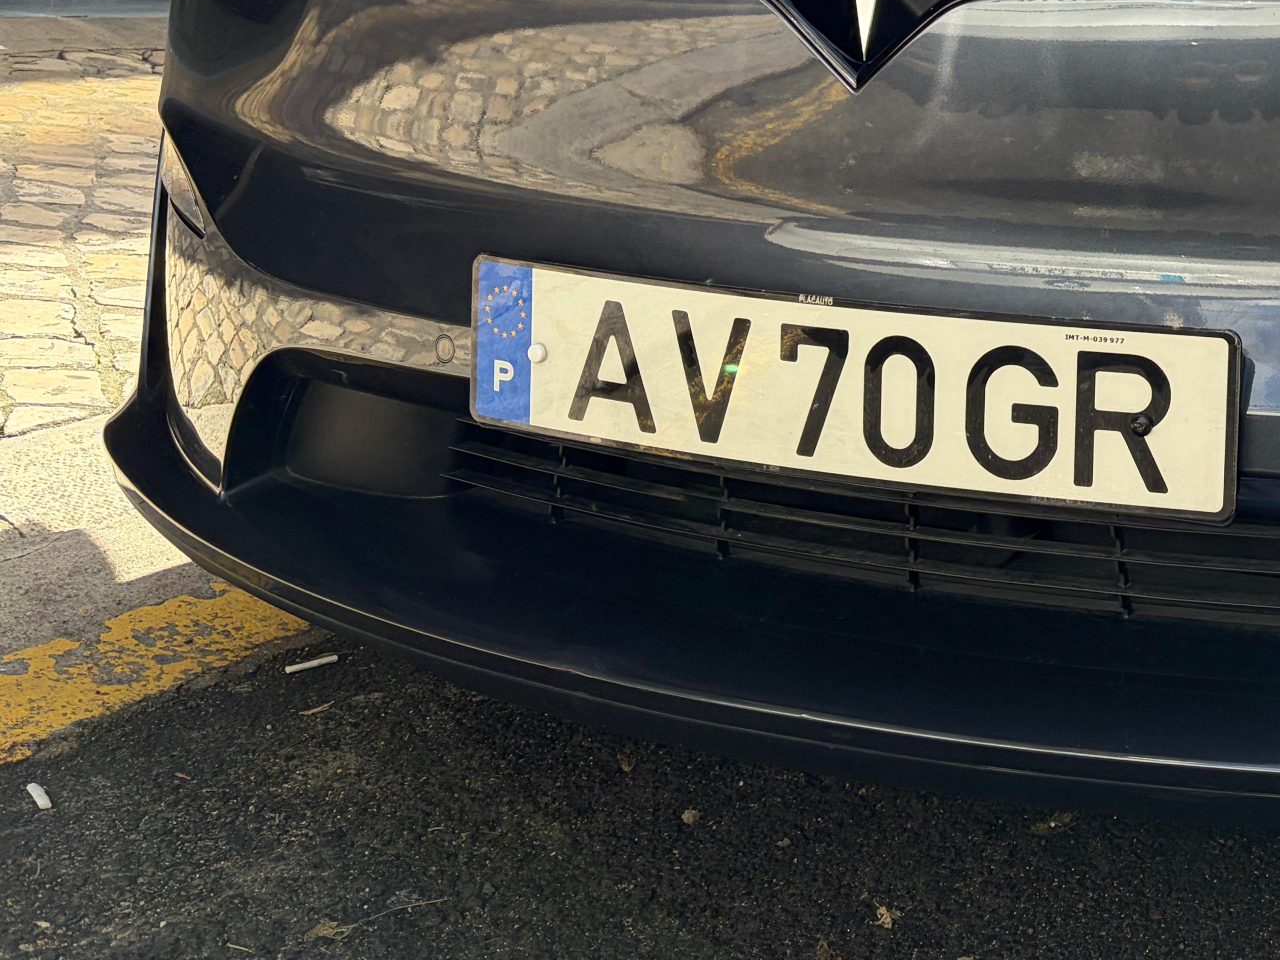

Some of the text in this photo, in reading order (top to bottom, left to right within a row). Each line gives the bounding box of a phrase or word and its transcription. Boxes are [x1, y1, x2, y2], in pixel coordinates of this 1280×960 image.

[492, 359, 515, 392] P
[568, 300, 1172, 494] AV 70 GR
